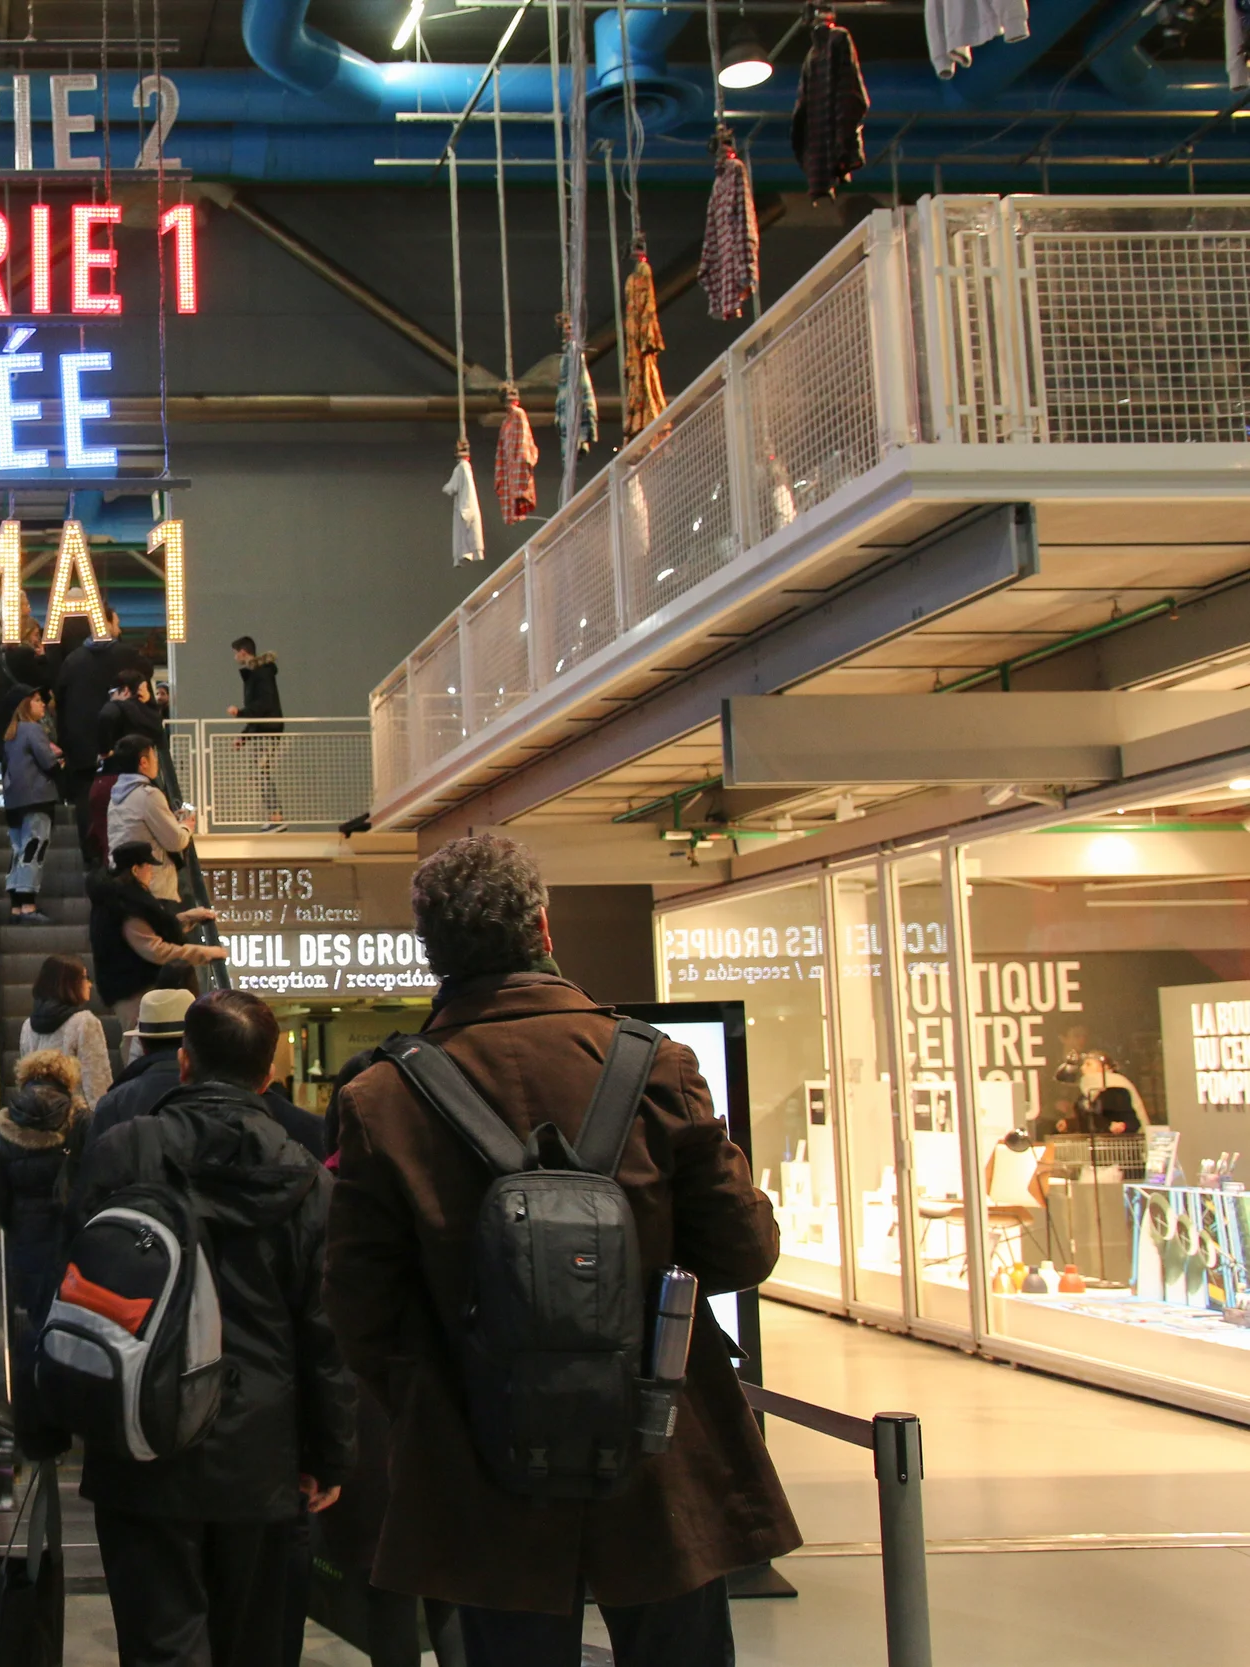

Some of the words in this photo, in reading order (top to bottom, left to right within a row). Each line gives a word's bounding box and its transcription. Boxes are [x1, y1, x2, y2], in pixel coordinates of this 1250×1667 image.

[133, 74, 181, 170] 2
[160, 204, 197, 315] 1
[147, 519, 186, 643] 1
[295, 905, 362, 922] talleres
[300, 932, 351, 967] DES
[238, 971, 329, 993] reception
[334, 969, 342, 990] /
[346, 968, 438, 992] recepción
[1191, 1002, 1216, 1036] LA
[1194, 1037, 1220, 1070] DU
